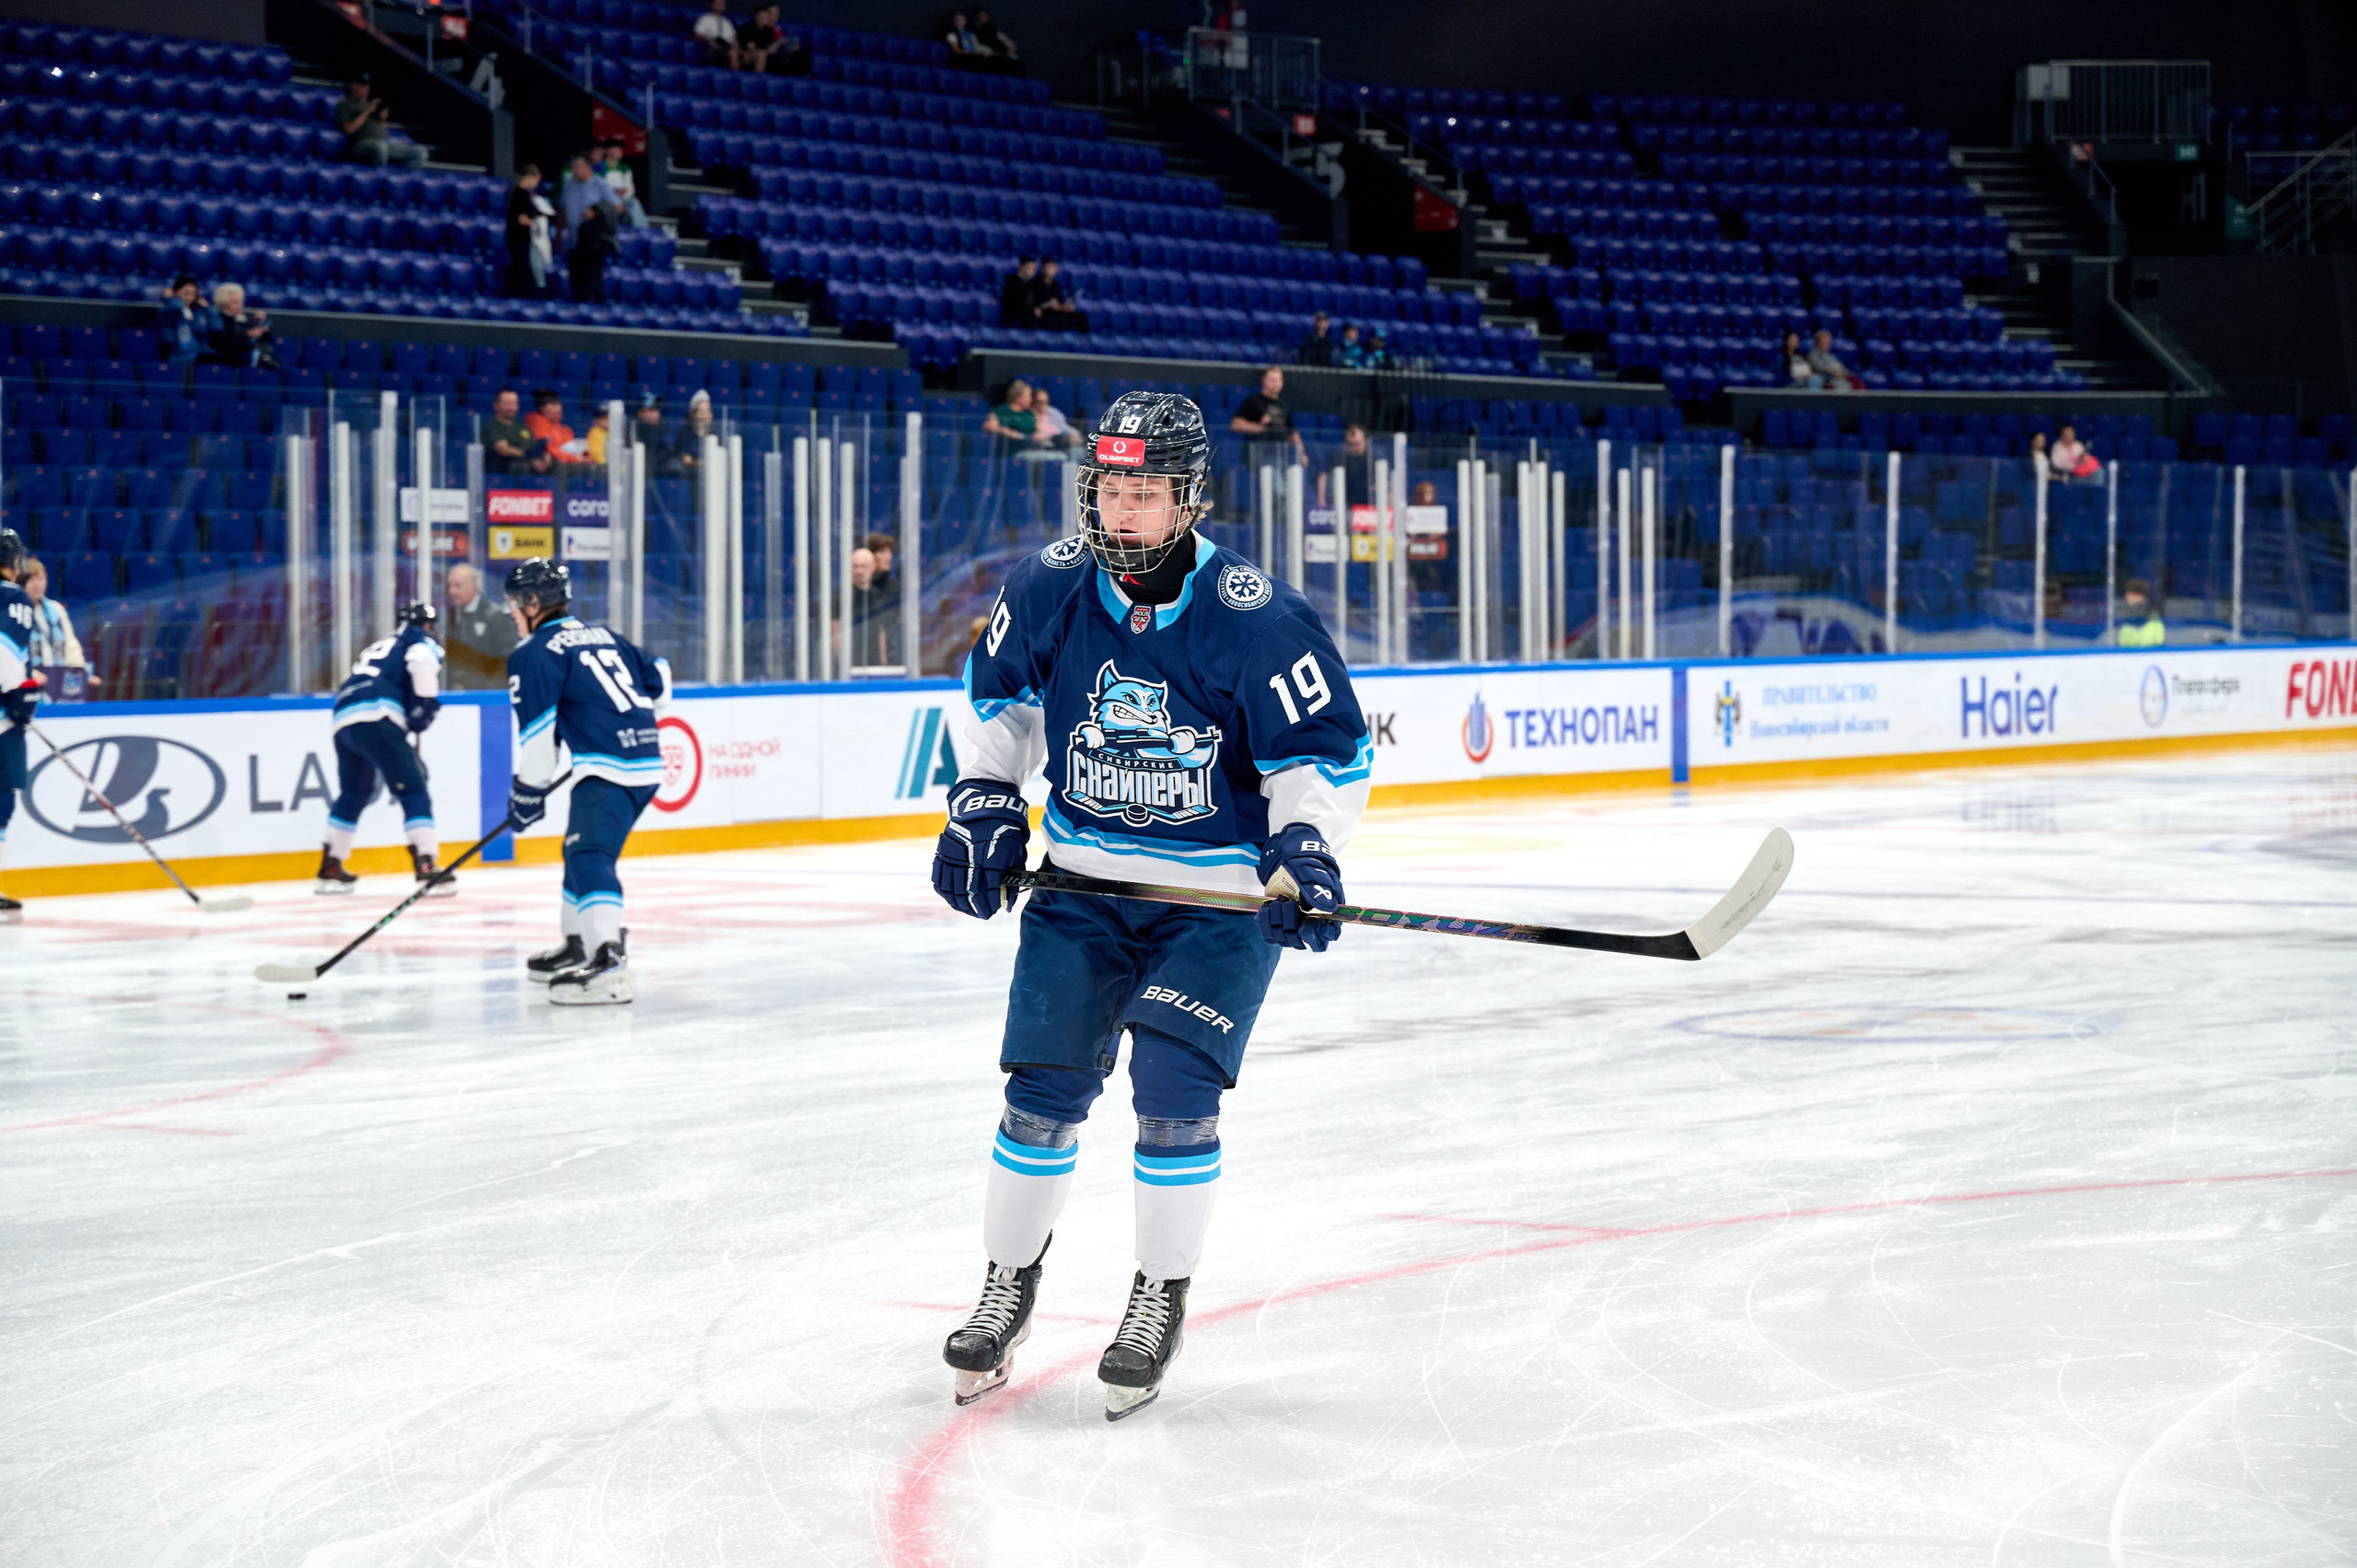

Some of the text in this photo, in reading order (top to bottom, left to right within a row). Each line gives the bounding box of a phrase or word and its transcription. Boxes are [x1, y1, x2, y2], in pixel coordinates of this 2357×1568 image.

[1118, 415, 1142, 434] 19
[1099, 454, 1140, 463] OLIMPBET
[489, 496, 552, 517] FONBET
[578, 648, 655, 714] 12
[1269, 650, 1331, 725] 19
[1961, 671, 2058, 738] Haier
[1504, 704, 1659, 748] ТЕХНОПАН
[1098, 752, 1174, 770] СИБИРСКИЕ
